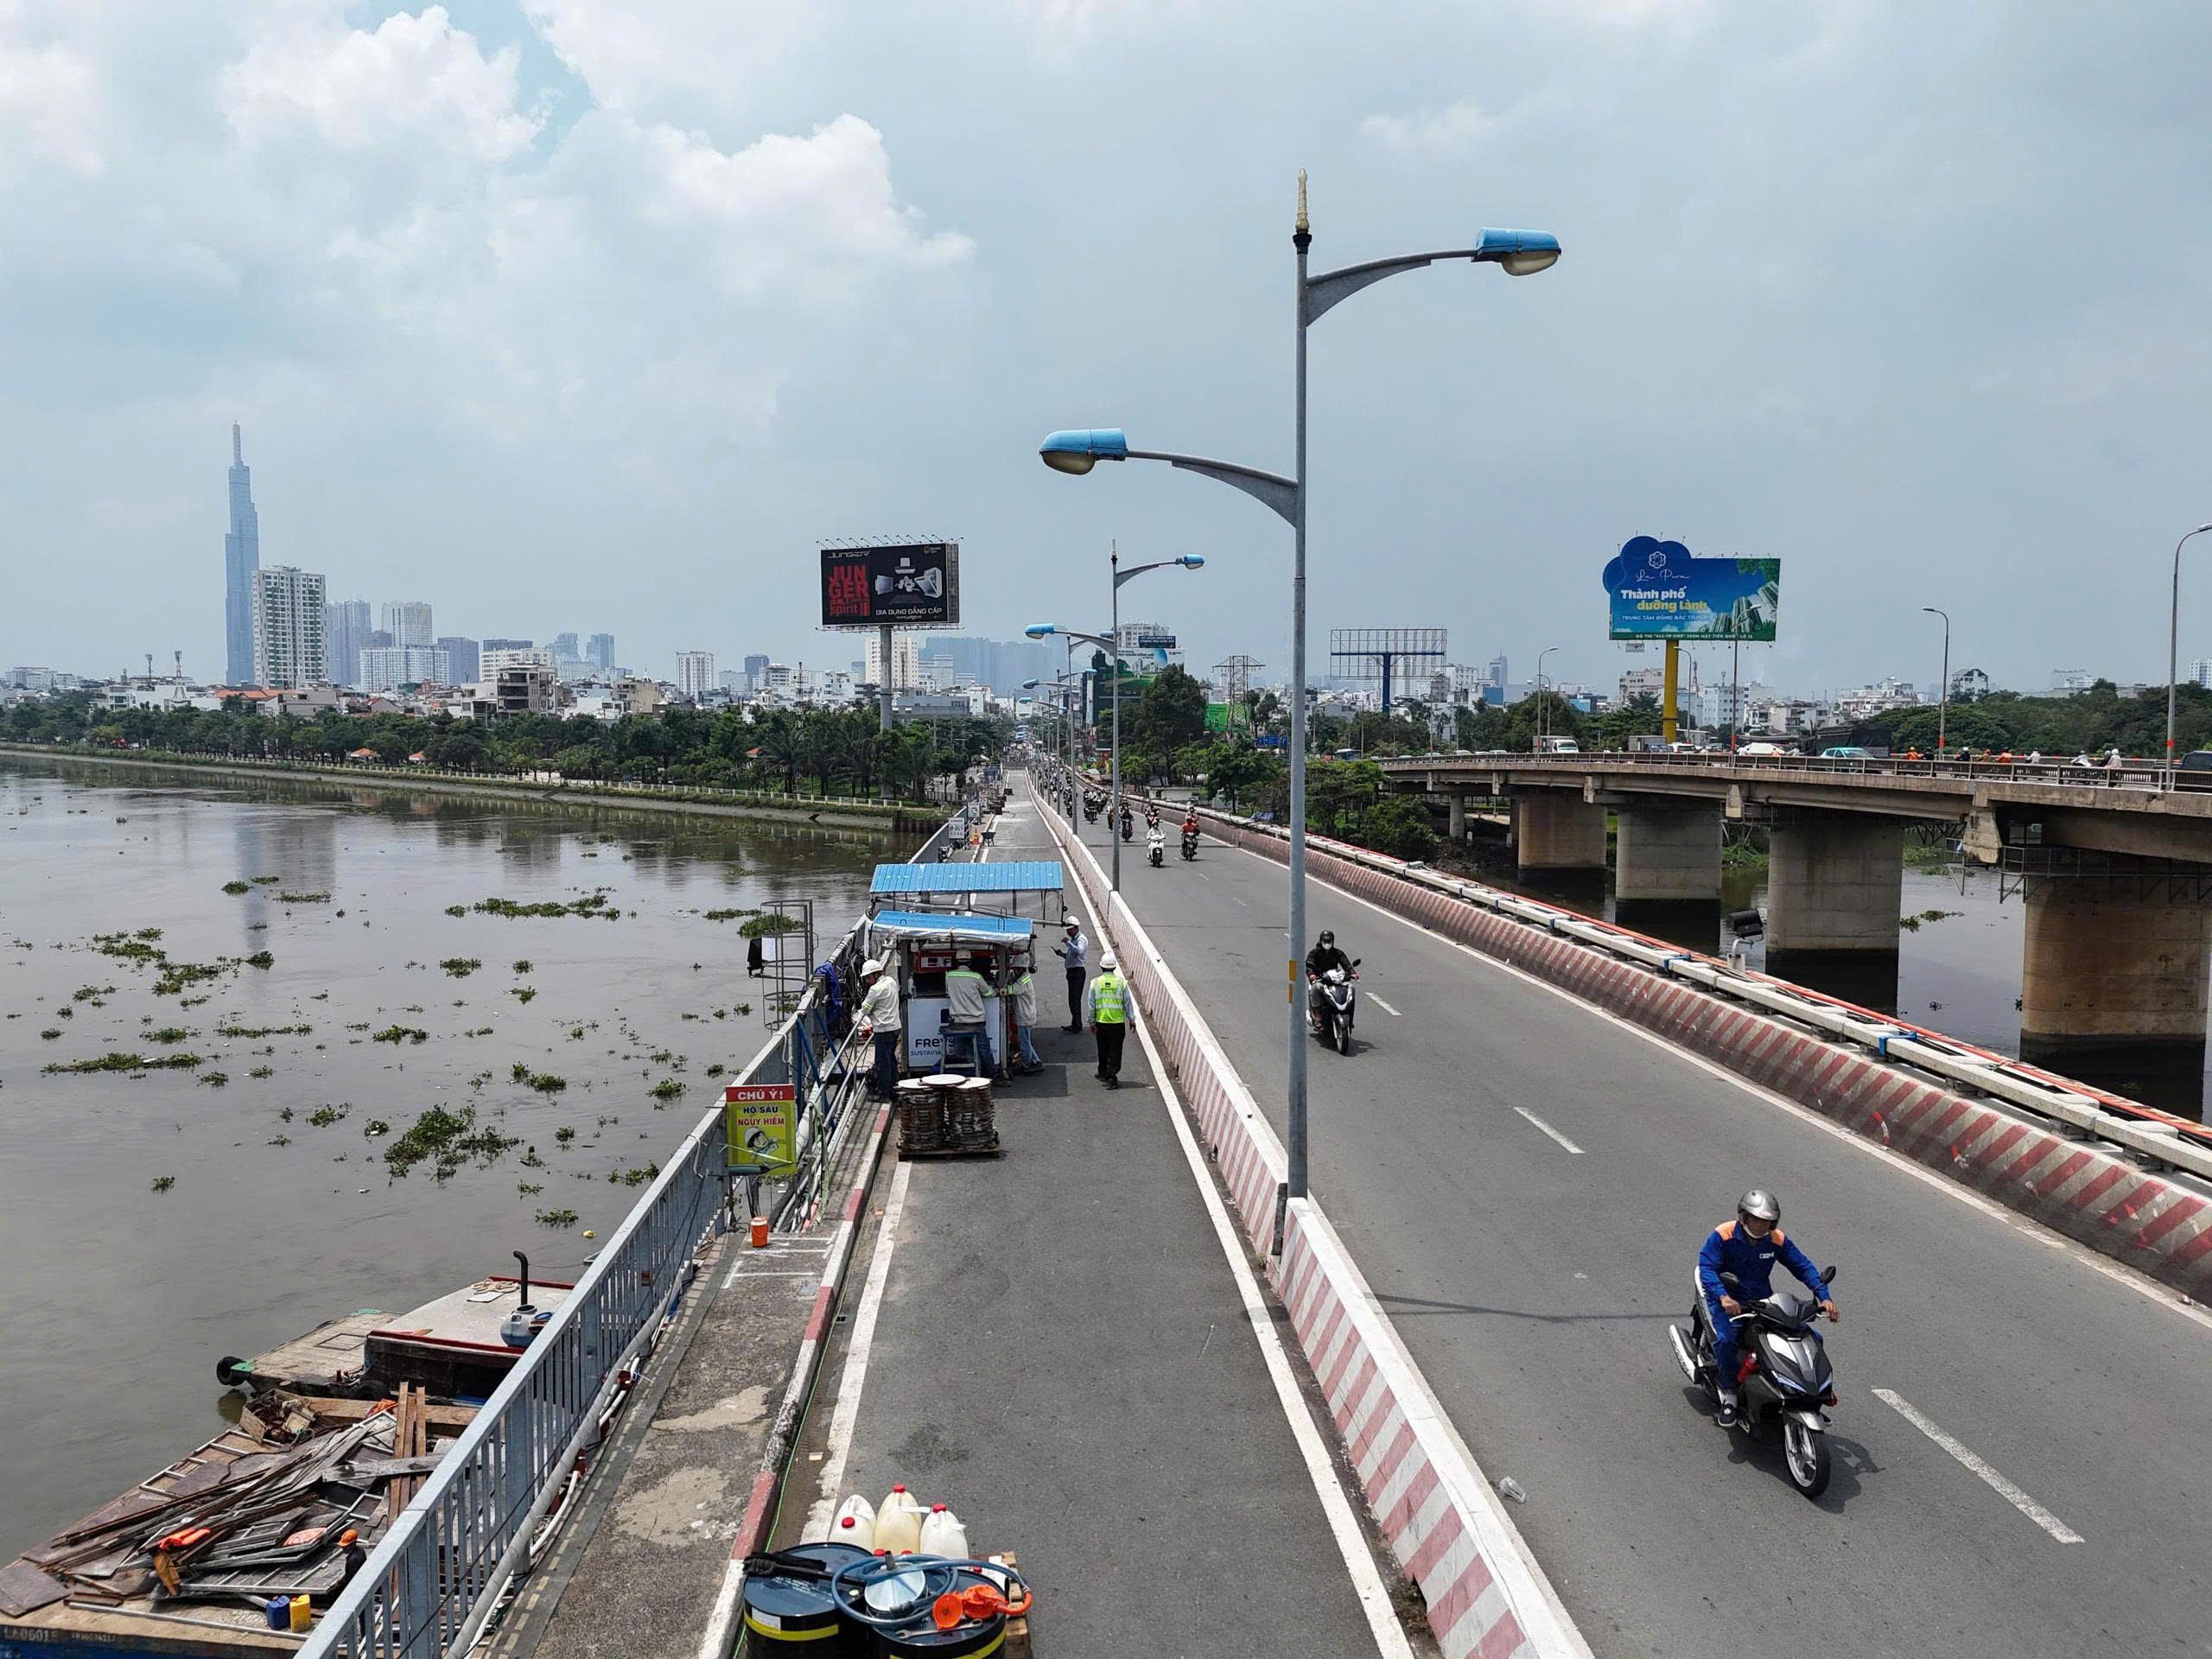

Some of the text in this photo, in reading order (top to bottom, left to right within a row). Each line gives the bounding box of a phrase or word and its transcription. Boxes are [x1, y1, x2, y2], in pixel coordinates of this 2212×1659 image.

[830, 565, 867, 582] JUN
[829, 581, 869, 598] GER
[1620, 586, 1687, 600] Thành phố
[1637, 599, 1677, 613] dưỡng
[737, 1089, 784, 1100] CHÚ Ý!
[760, 1104, 779, 1113] SÂU
